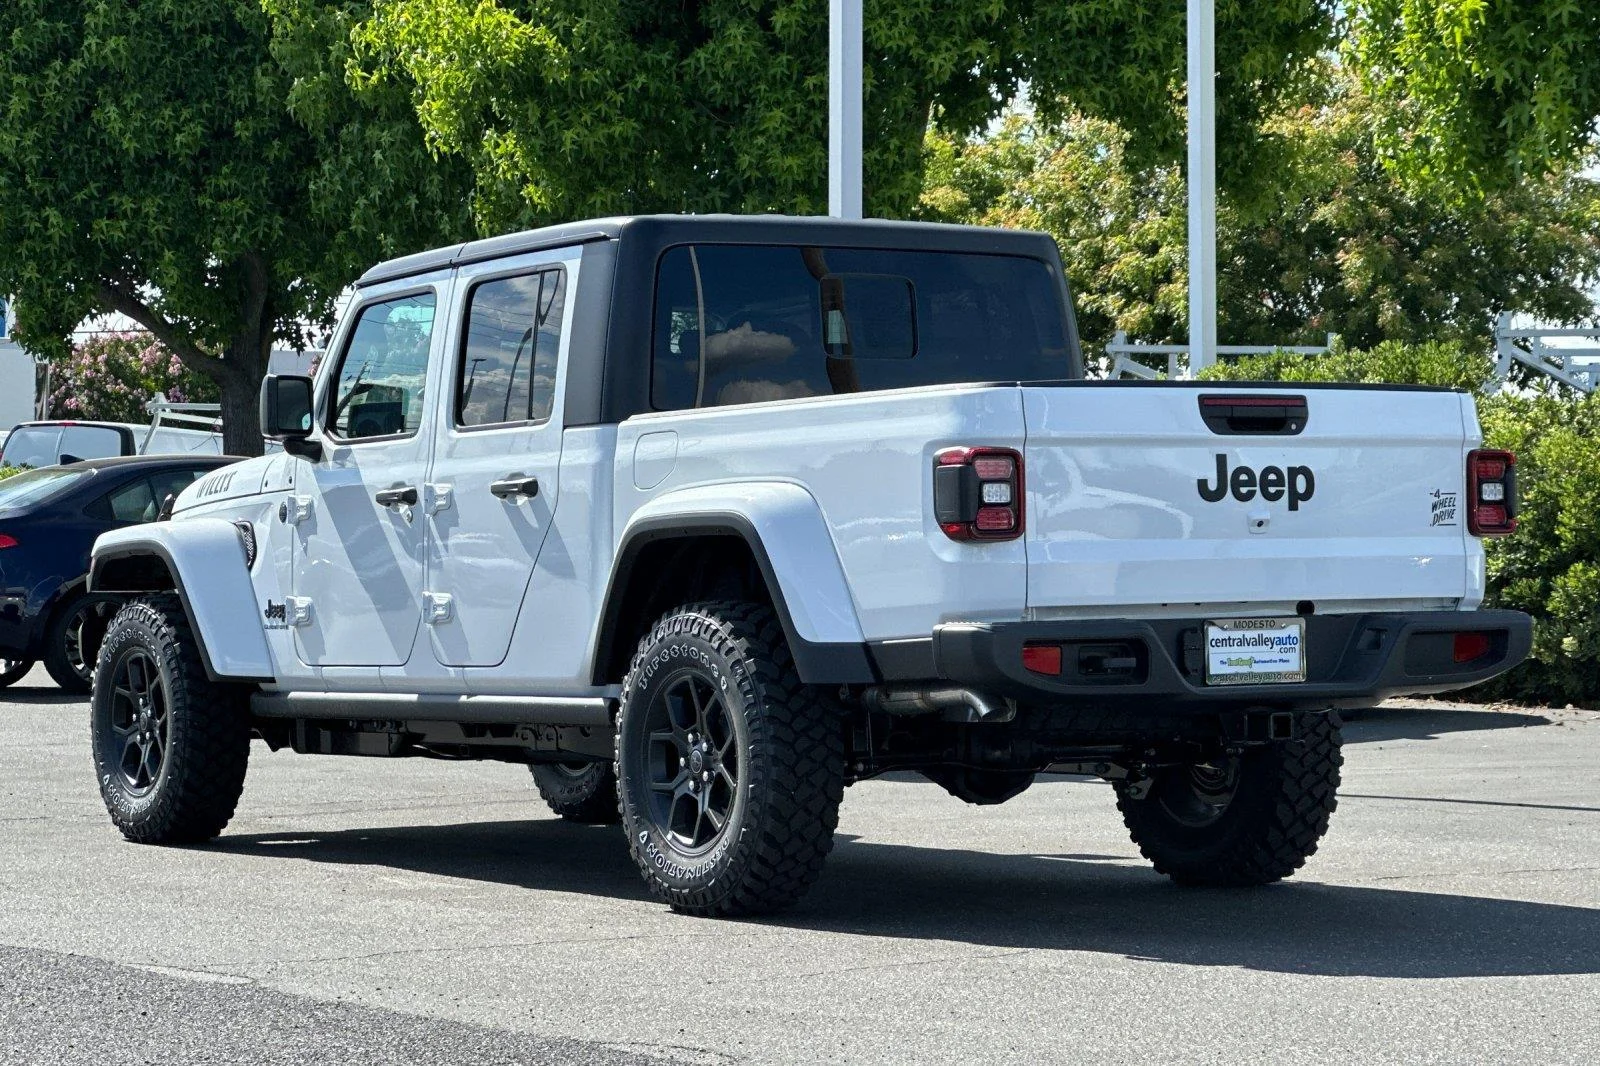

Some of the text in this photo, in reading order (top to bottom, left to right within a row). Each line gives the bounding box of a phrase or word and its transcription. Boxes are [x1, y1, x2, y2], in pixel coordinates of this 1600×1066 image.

[1197, 453, 1315, 511] Jeep
[1433, 488, 1441, 499] 4
[1431, 497, 1456, 513] WHEEL
[1431, 509, 1456, 527] DRIVE
[264, 598, 286, 622] Jeep
[1233, 619, 1276, 629] MODESTO
[1210, 632, 1299, 650] centralvalleyauto
[1277, 645, 1297, 654] .com
[638, 642, 719, 690] Firestone
[646, 834, 730, 879] DESTINATION
